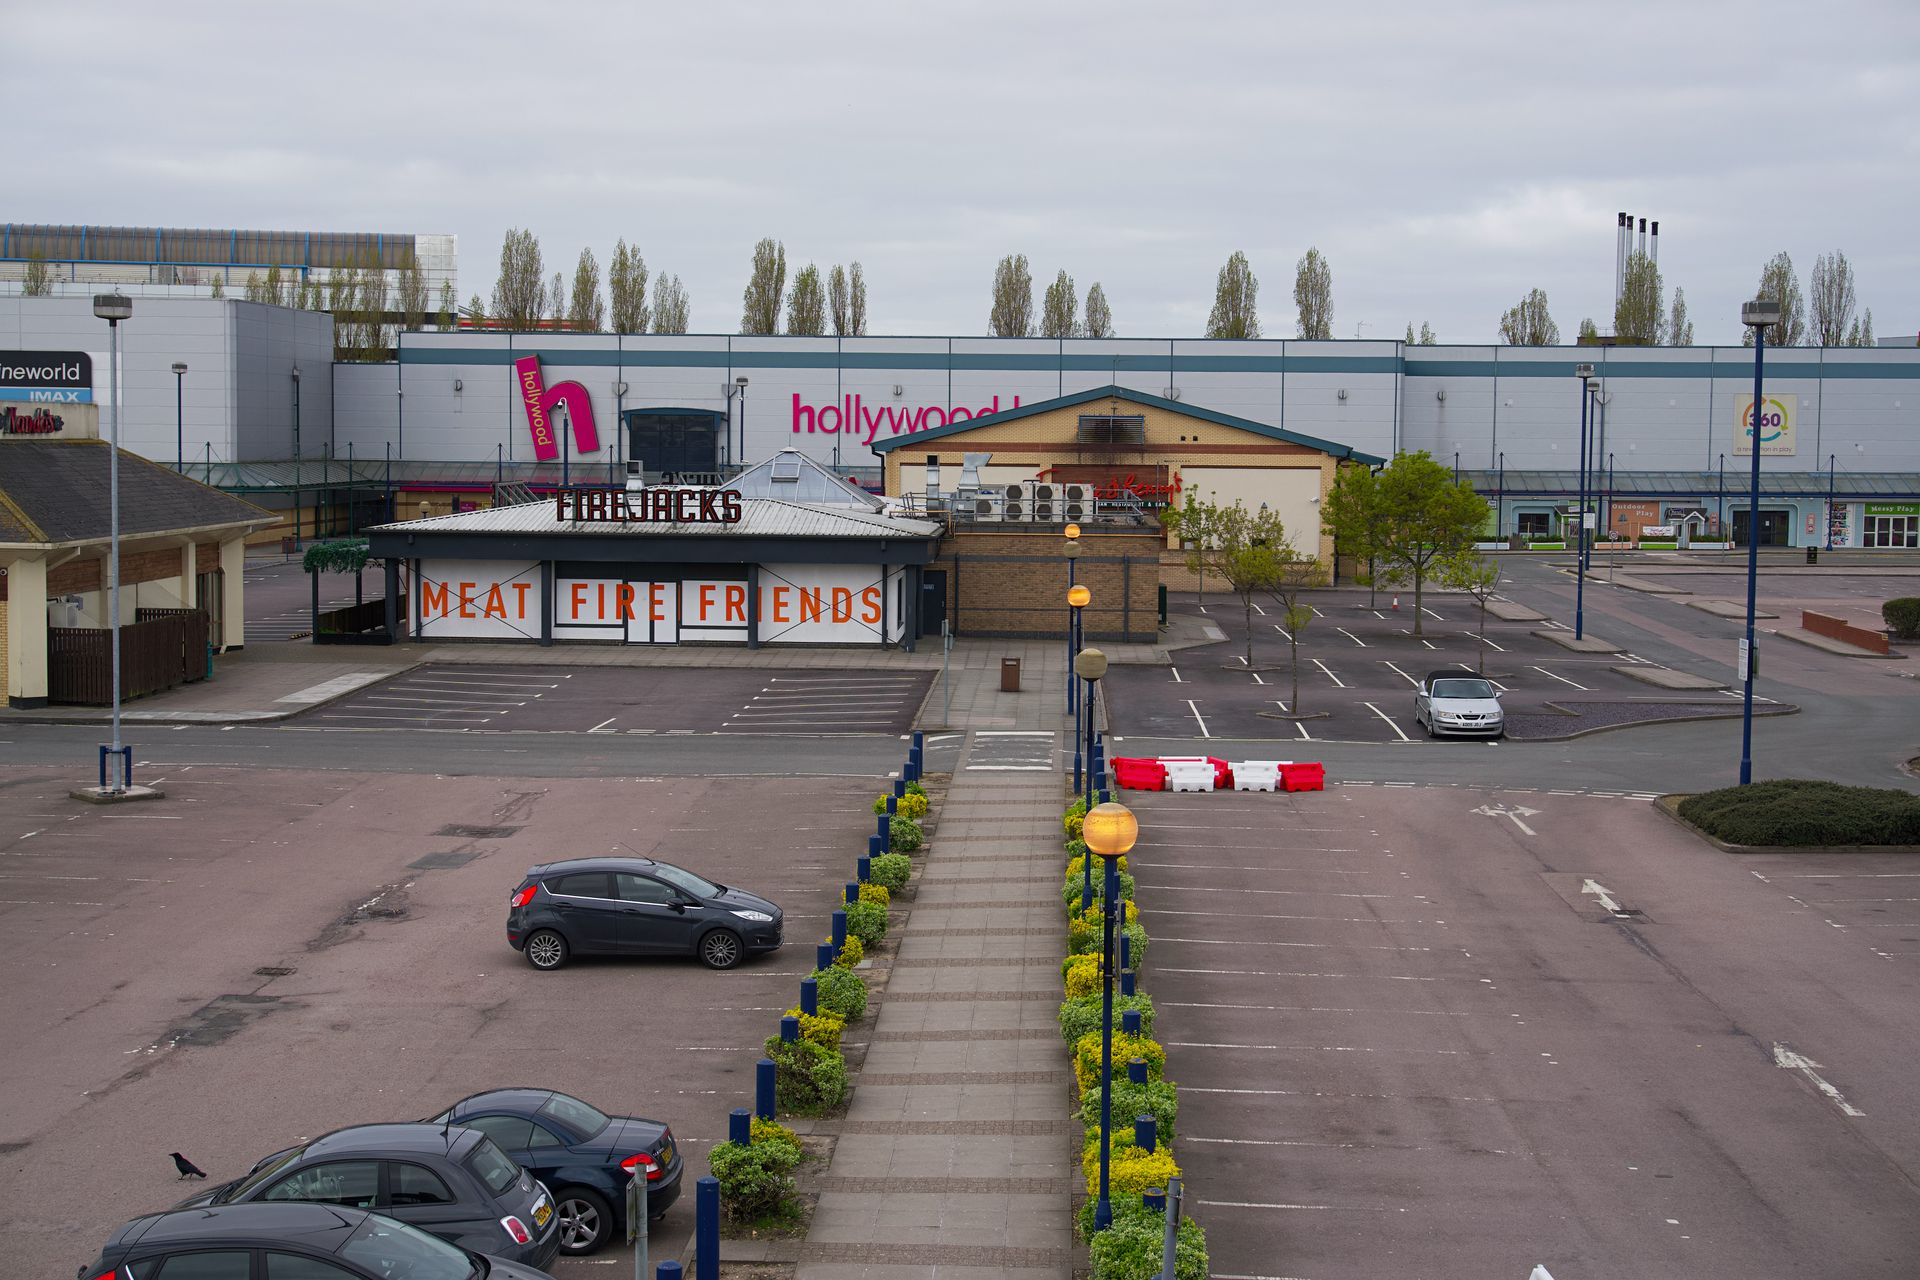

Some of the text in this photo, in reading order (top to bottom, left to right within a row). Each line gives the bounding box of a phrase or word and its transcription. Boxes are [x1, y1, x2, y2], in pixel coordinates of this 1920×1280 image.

[30, 391, 79, 402] IMAX
[523, 371, 552, 446] hollywood
[1749, 413, 1781, 427] 360
[556, 489, 742, 523] FIREJACKS
[422, 581, 881, 624] MEAT FIRE FRIENDS
